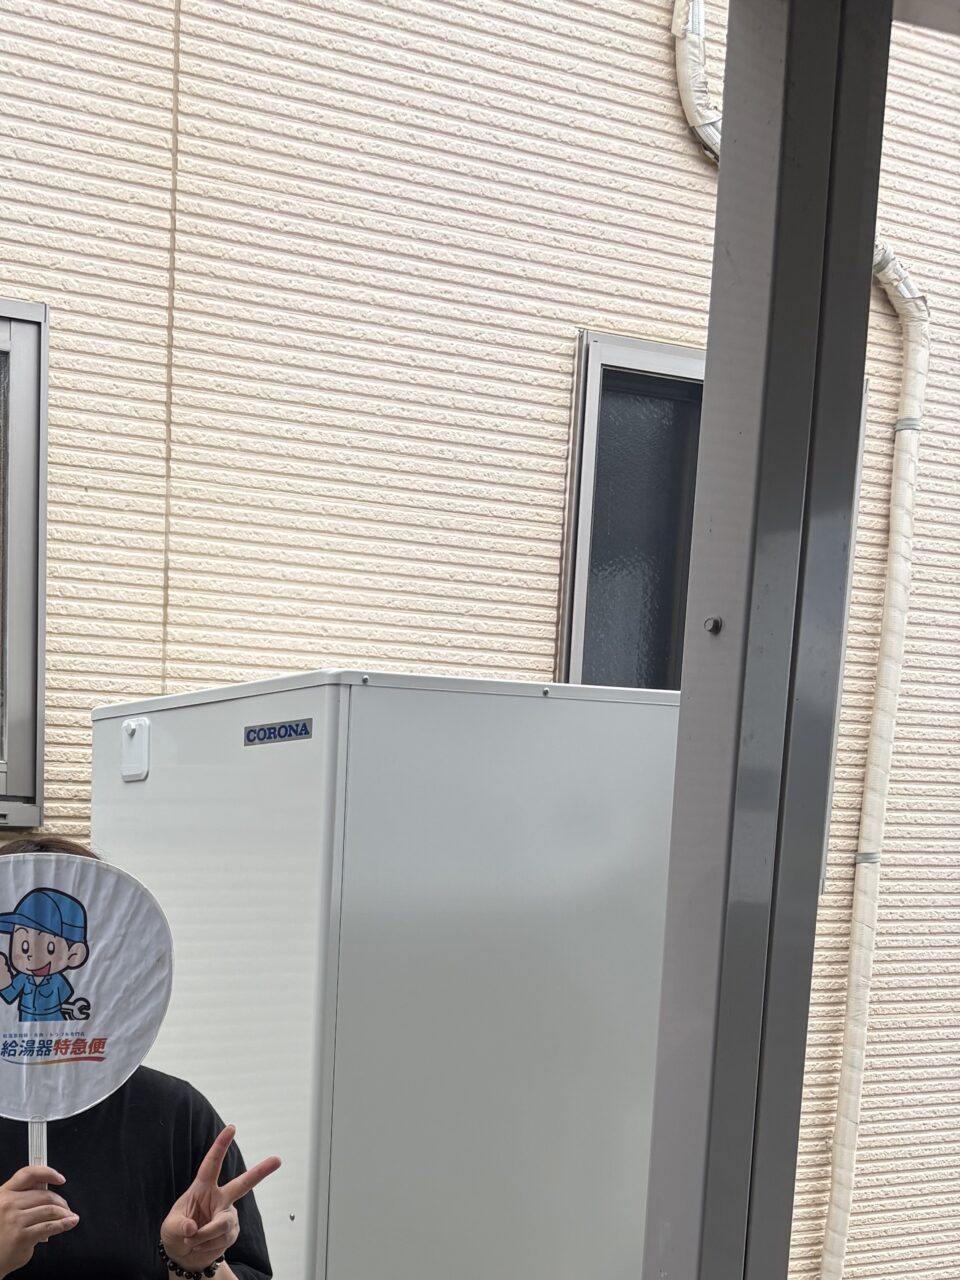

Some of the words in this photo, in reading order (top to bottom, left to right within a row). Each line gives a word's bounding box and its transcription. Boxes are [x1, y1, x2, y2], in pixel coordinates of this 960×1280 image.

[246, 722, 310, 743] CORONA
[0, 1037, 108, 1057] 給湯器特急便
